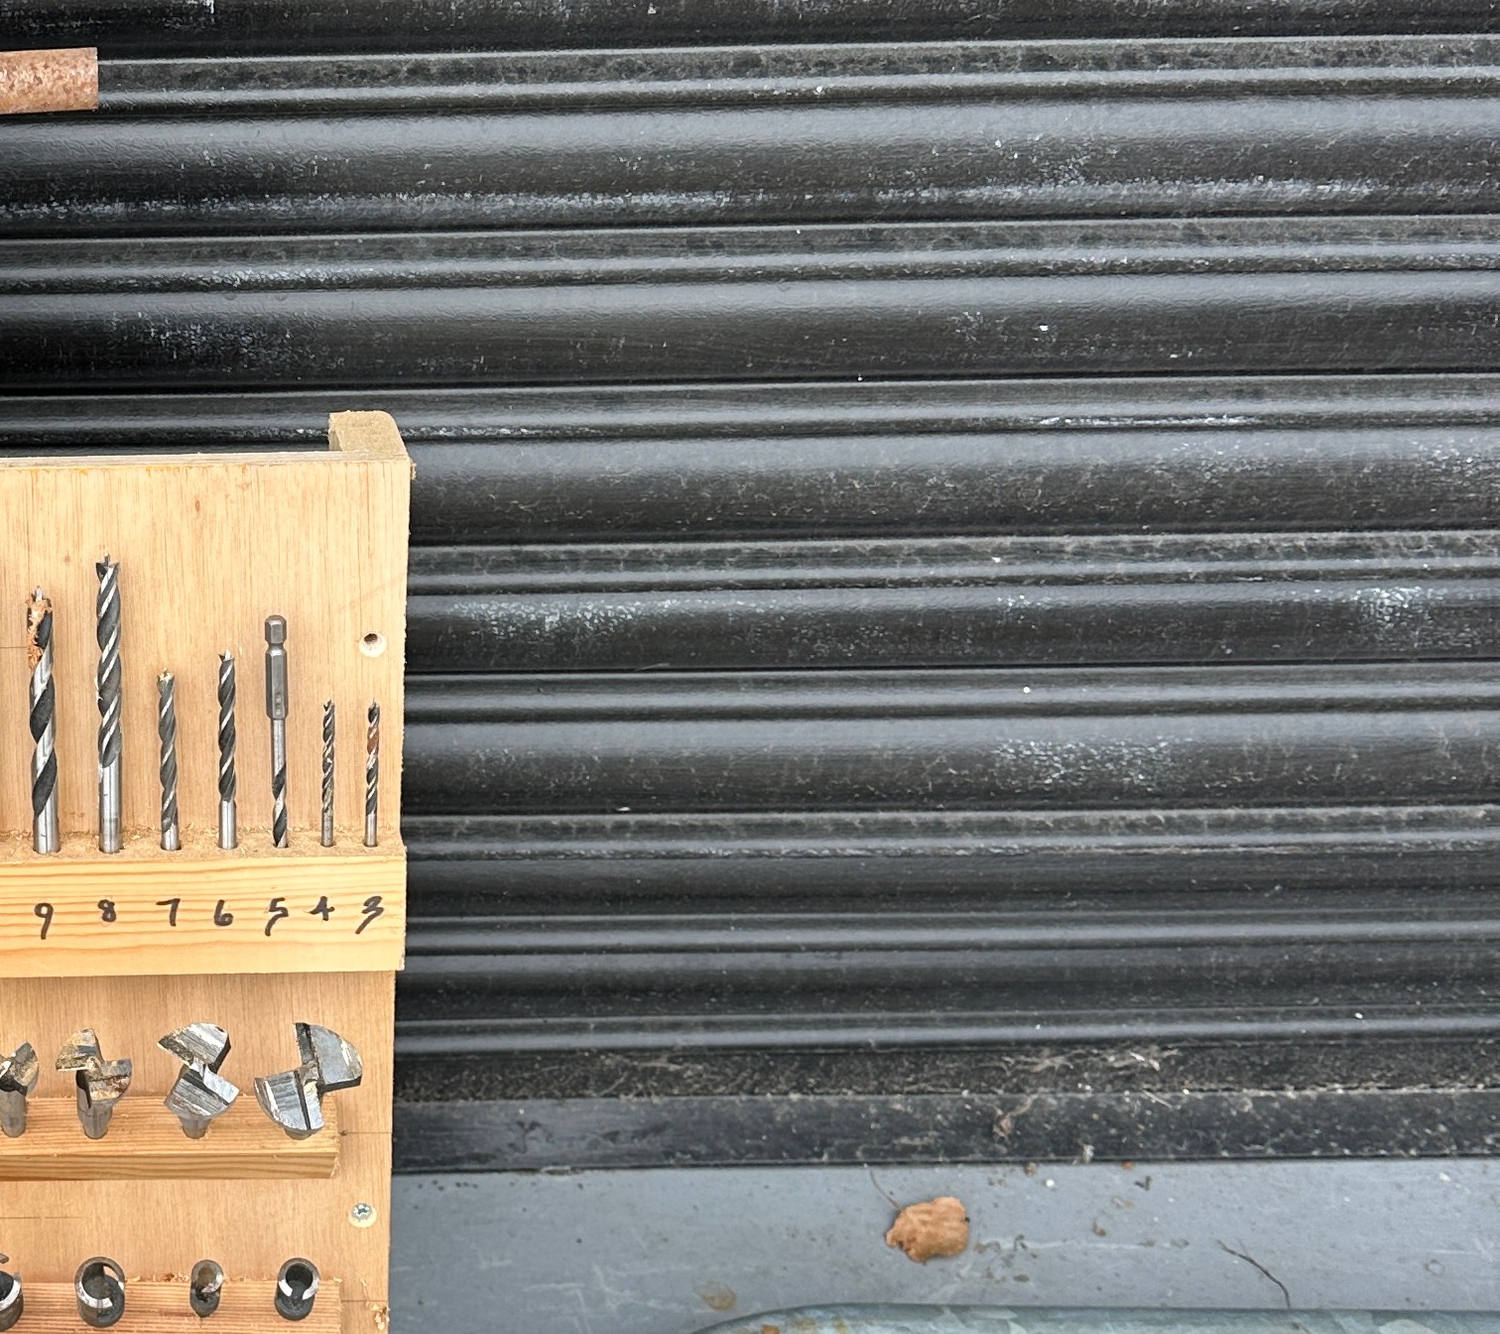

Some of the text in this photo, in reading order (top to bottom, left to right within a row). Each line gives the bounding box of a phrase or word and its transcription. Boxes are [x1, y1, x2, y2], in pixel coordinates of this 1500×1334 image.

[33, 902, 54, 940] 9
[97, 899, 117, 923] 8
[155, 898, 181, 927] 7
[212, 900, 234, 927] 6
[265, 897, 289, 936] 5
[309, 895, 335, 921] 4
[355, 895, 385, 935] 3
